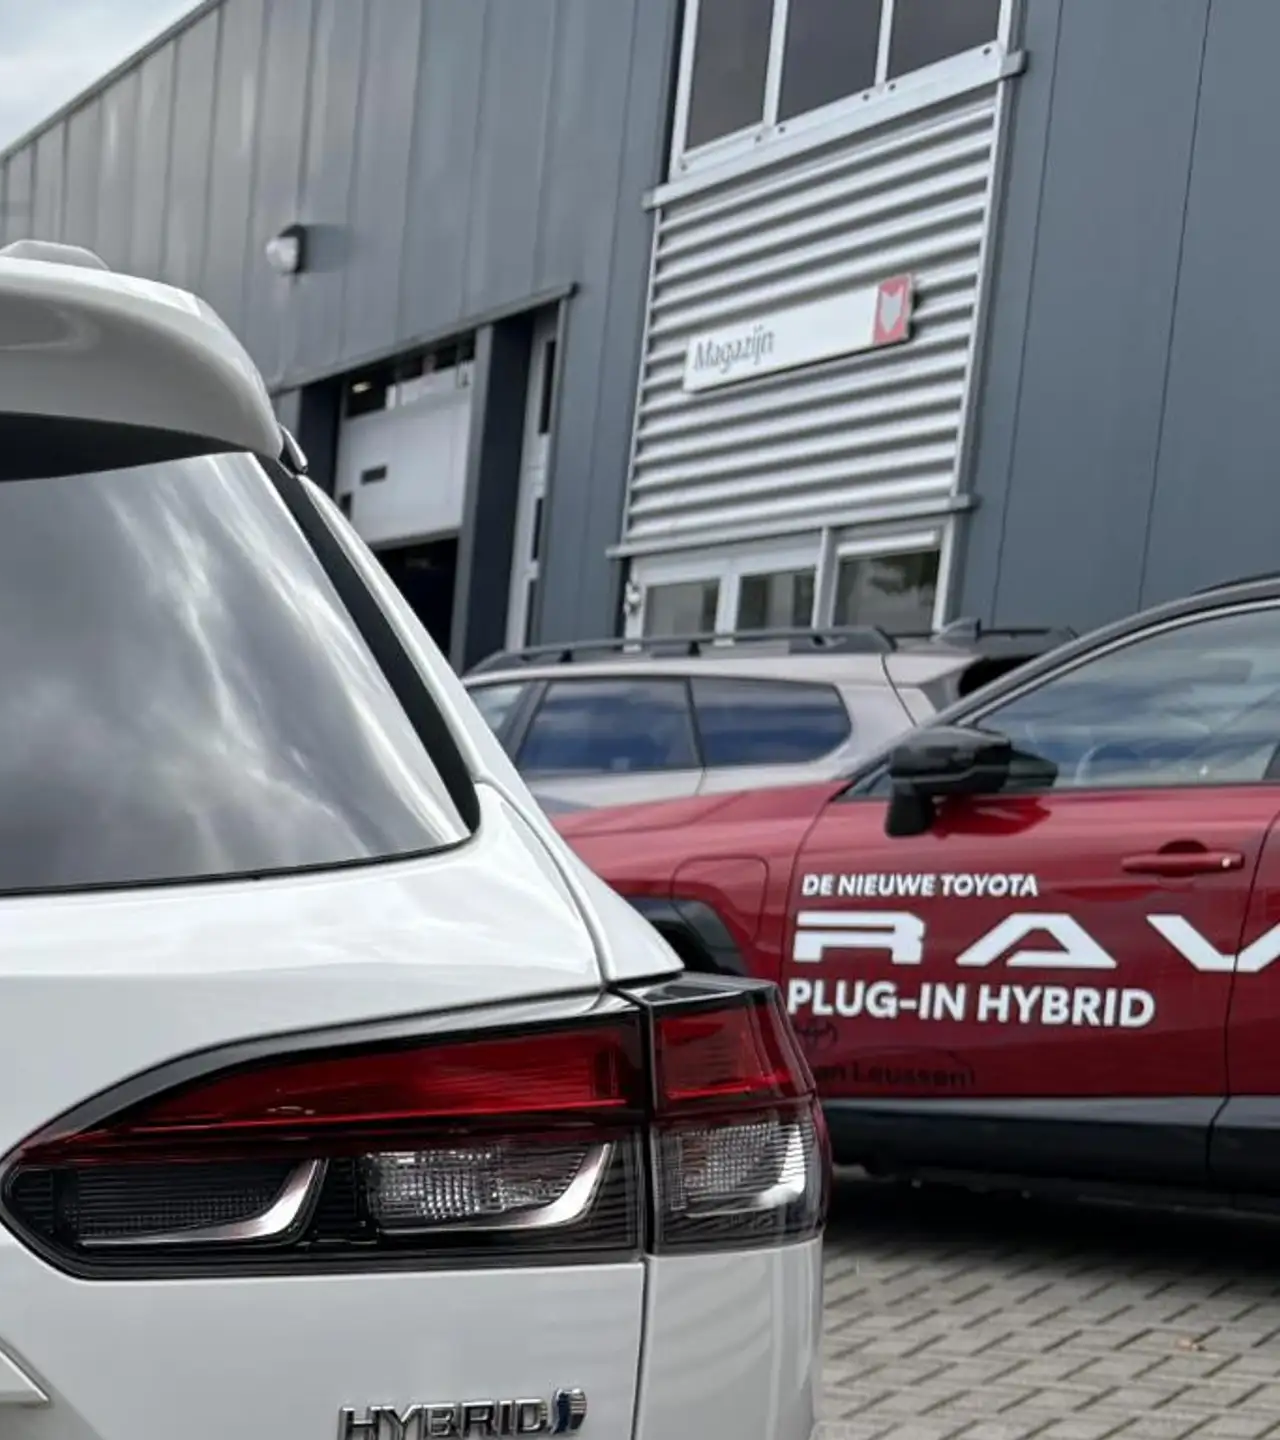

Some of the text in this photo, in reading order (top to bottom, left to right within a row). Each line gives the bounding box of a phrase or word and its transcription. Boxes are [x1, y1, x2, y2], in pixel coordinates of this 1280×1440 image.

[693, 324, 775, 374] Magazijn
[802, 873, 1039, 897] DE NIEUWE TOYOTA
[787, 978, 1156, 1028] PLUG-IN HYBRID
